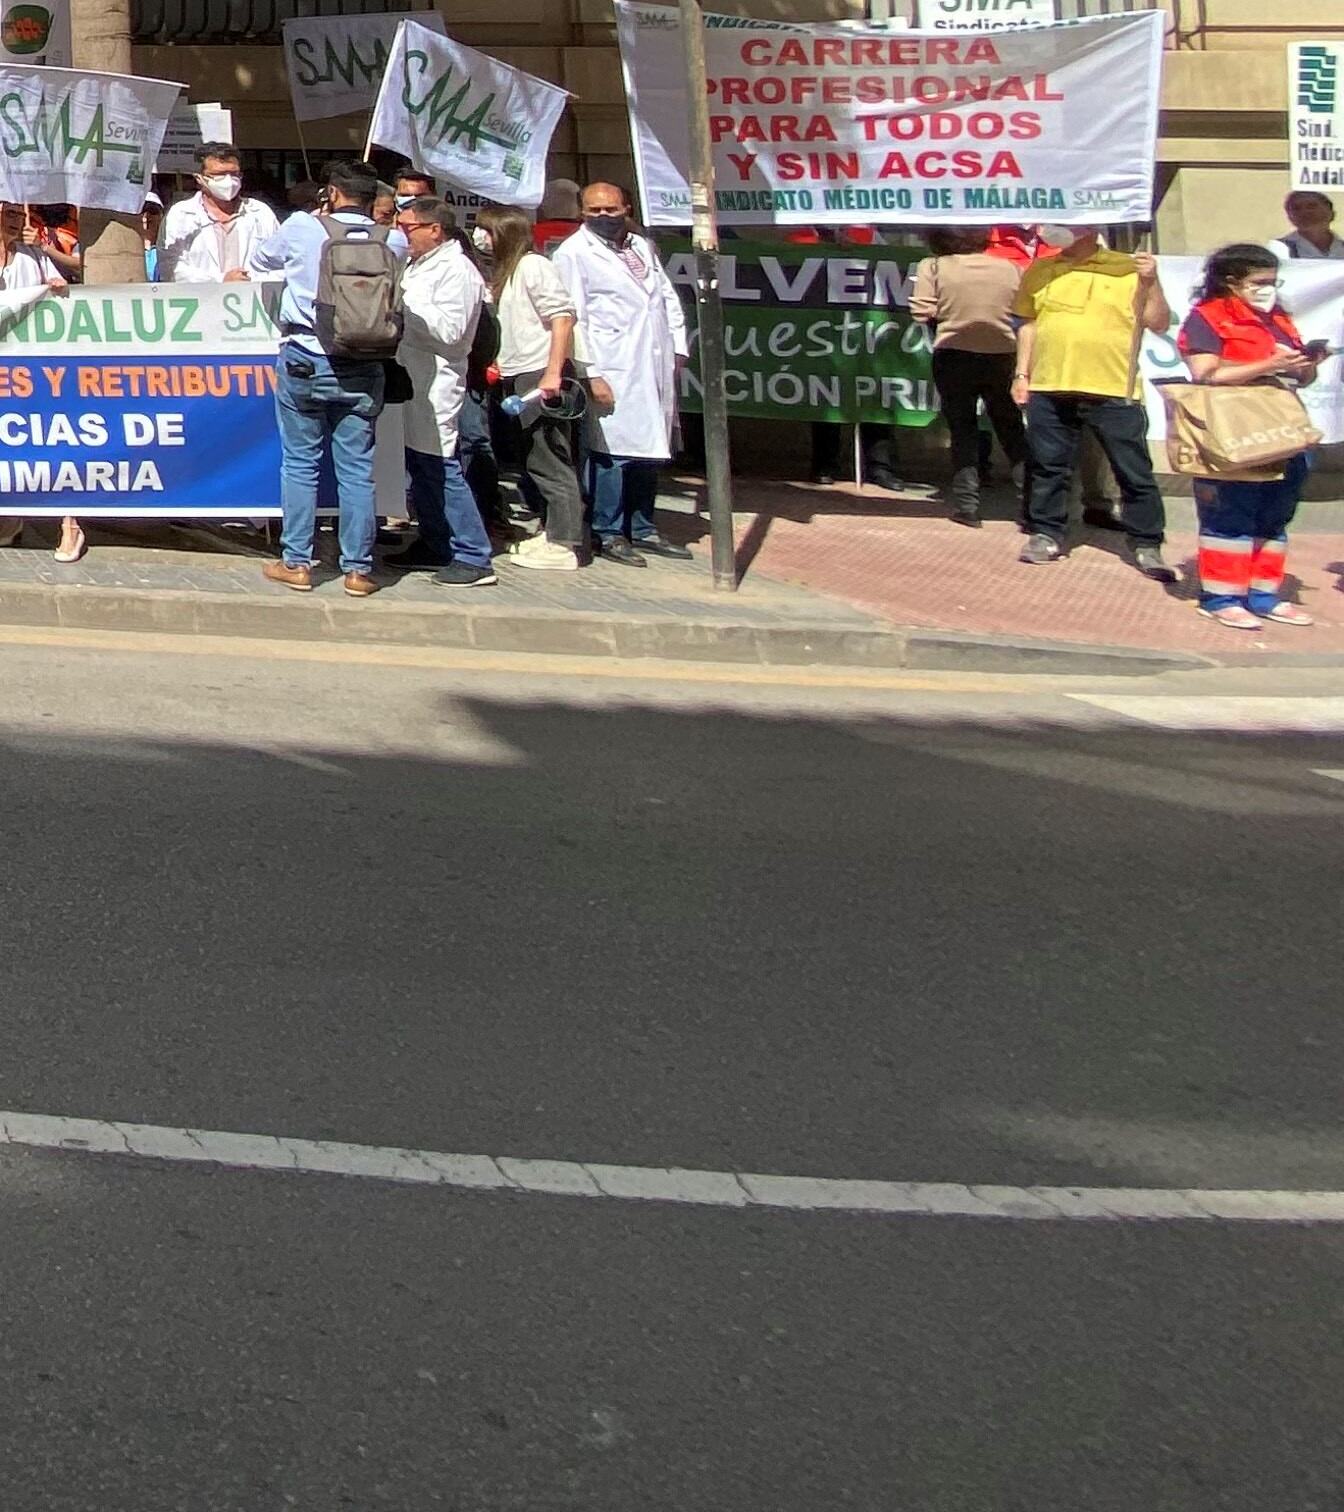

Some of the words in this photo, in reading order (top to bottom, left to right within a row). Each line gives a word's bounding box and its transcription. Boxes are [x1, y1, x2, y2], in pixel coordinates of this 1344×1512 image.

[741, 38, 1002, 66] CARRERA
[402, 49, 518, 151] SMA
[485, 113, 532, 145] Sevilla
[0, 91, 143, 168] SMA
[712, 114, 838, 142] PARA
[855, 110, 1042, 141] TODOS
[728, 154, 758, 181] Y
[777, 152, 861, 180] SIN
[878, 151, 1024, 180] ACSA
[1298, 142, 1344, 161] Médic
[716, 188, 813, 211] INDICATO
[825, 184, 912, 210] MÉDICO
[925, 189, 952, 209] DE
[963, 183, 1067, 210] MÁLAGA
[42, 367, 66, 398] Y
[122, 412, 185, 447] DE
